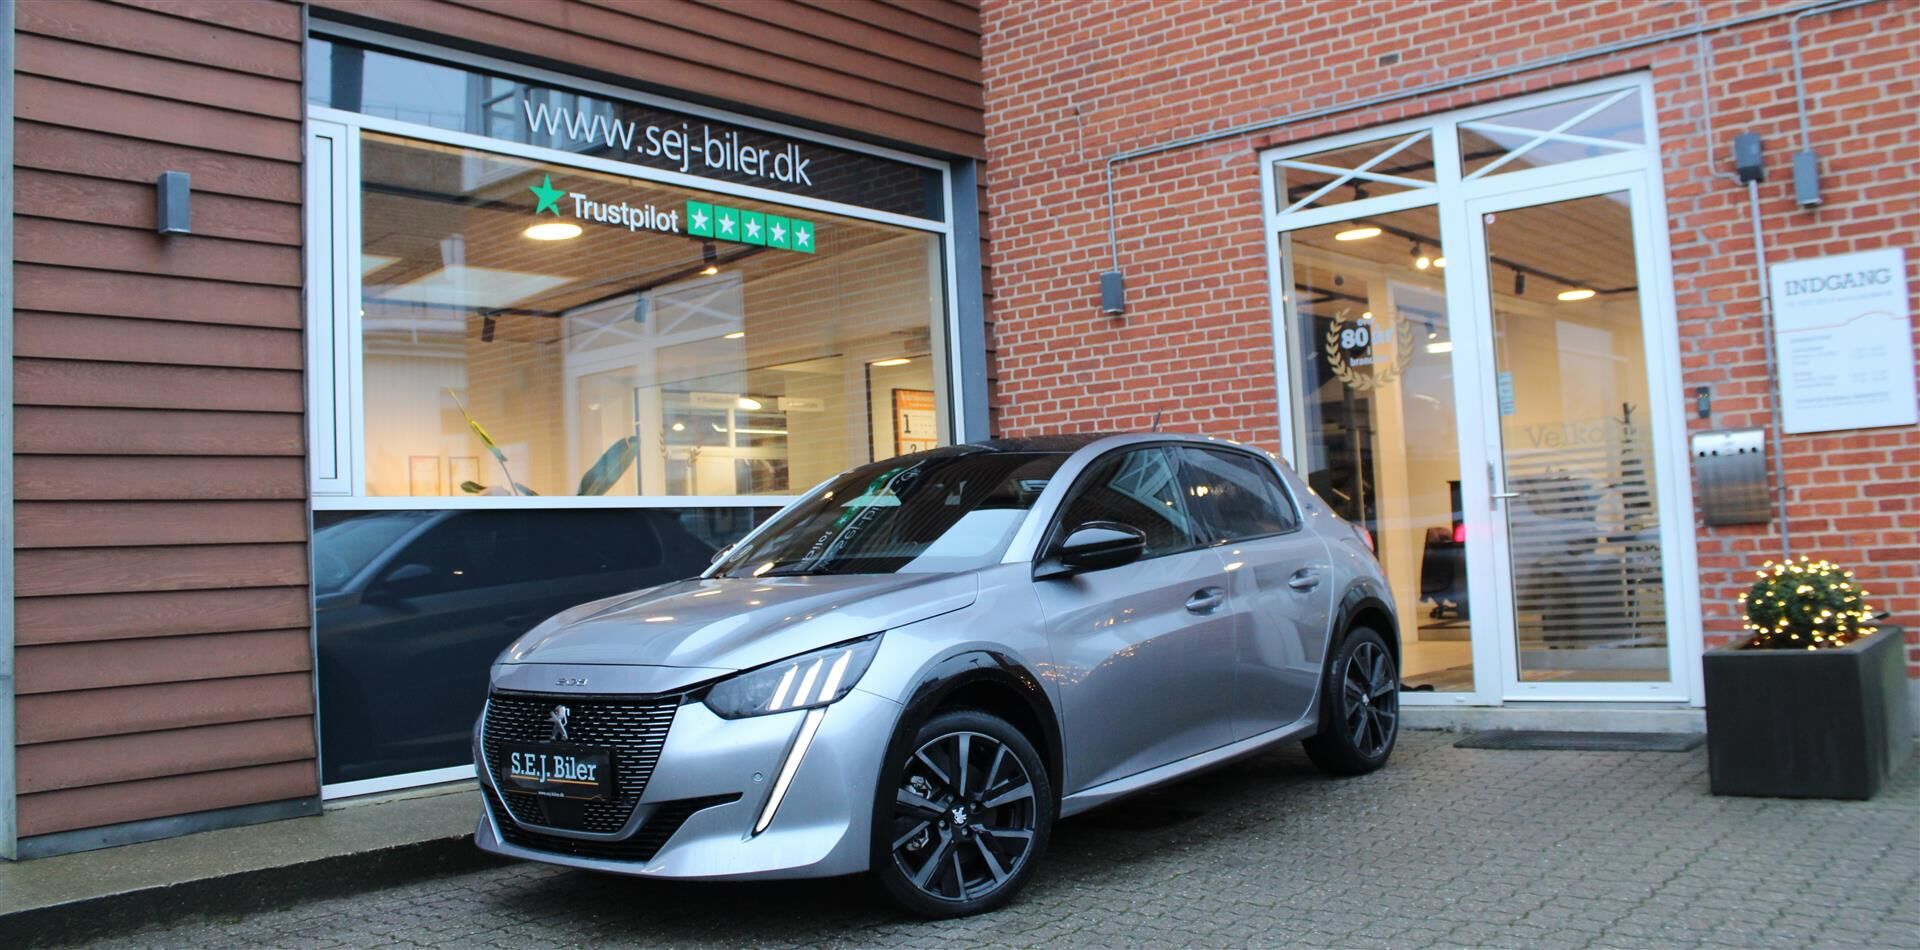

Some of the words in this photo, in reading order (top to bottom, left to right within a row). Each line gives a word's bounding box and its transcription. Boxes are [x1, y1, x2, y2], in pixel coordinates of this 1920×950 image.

[524, 100, 813, 186] www.sej-biler.dk
[569, 192, 679, 233] Trustpilot
[1785, 268, 1892, 296] INDGANG
[1341, 327, 1369, 349] 80
[1524, 421, 1608, 449] Velko
[511, 752, 551, 783] S.E.J.
[553, 755, 597, 781] Biler
